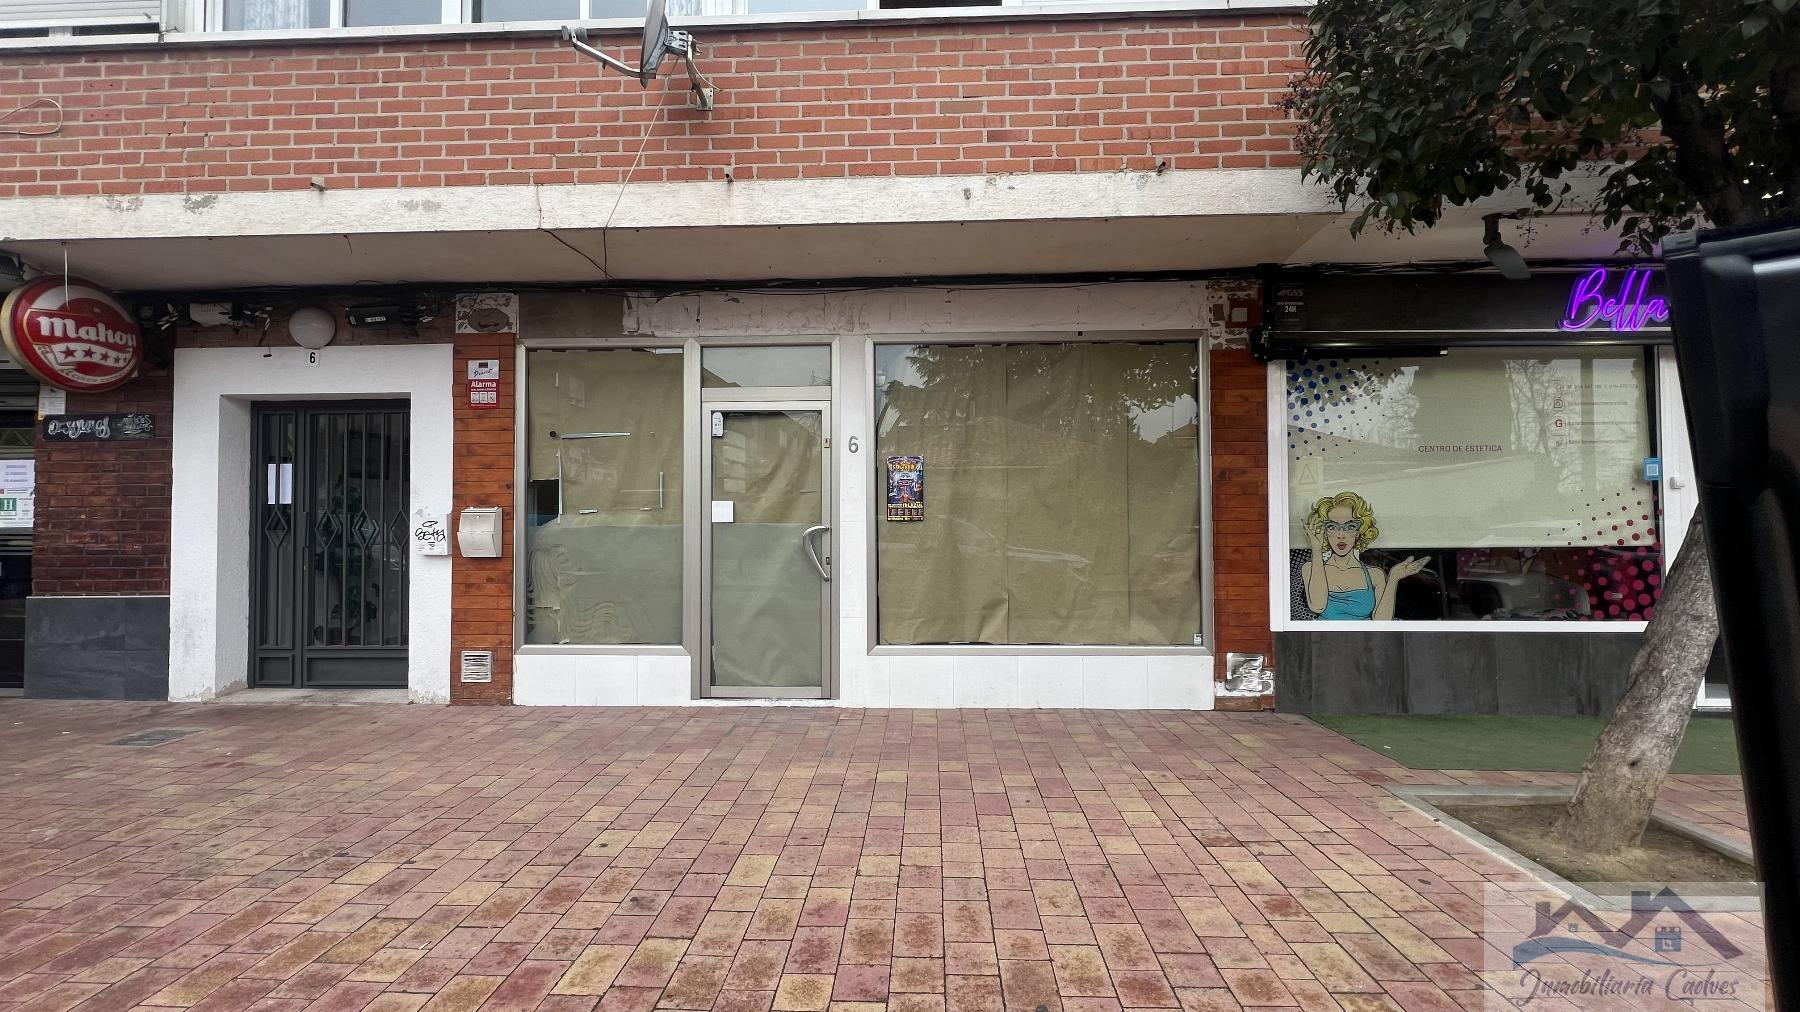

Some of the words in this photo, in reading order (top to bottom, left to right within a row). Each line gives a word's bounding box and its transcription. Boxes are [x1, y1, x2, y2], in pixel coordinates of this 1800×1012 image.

[1563, 267, 1669, 332] Bella
[309, 351, 316, 364] 6
[470, 380, 497, 388] Alarma
[848, 435, 860, 454] 6
[1418, 445, 1451, 453] CENTRO
[1452, 445, 1463, 453] DE
[1465, 445, 1503, 453] ESTETICA
